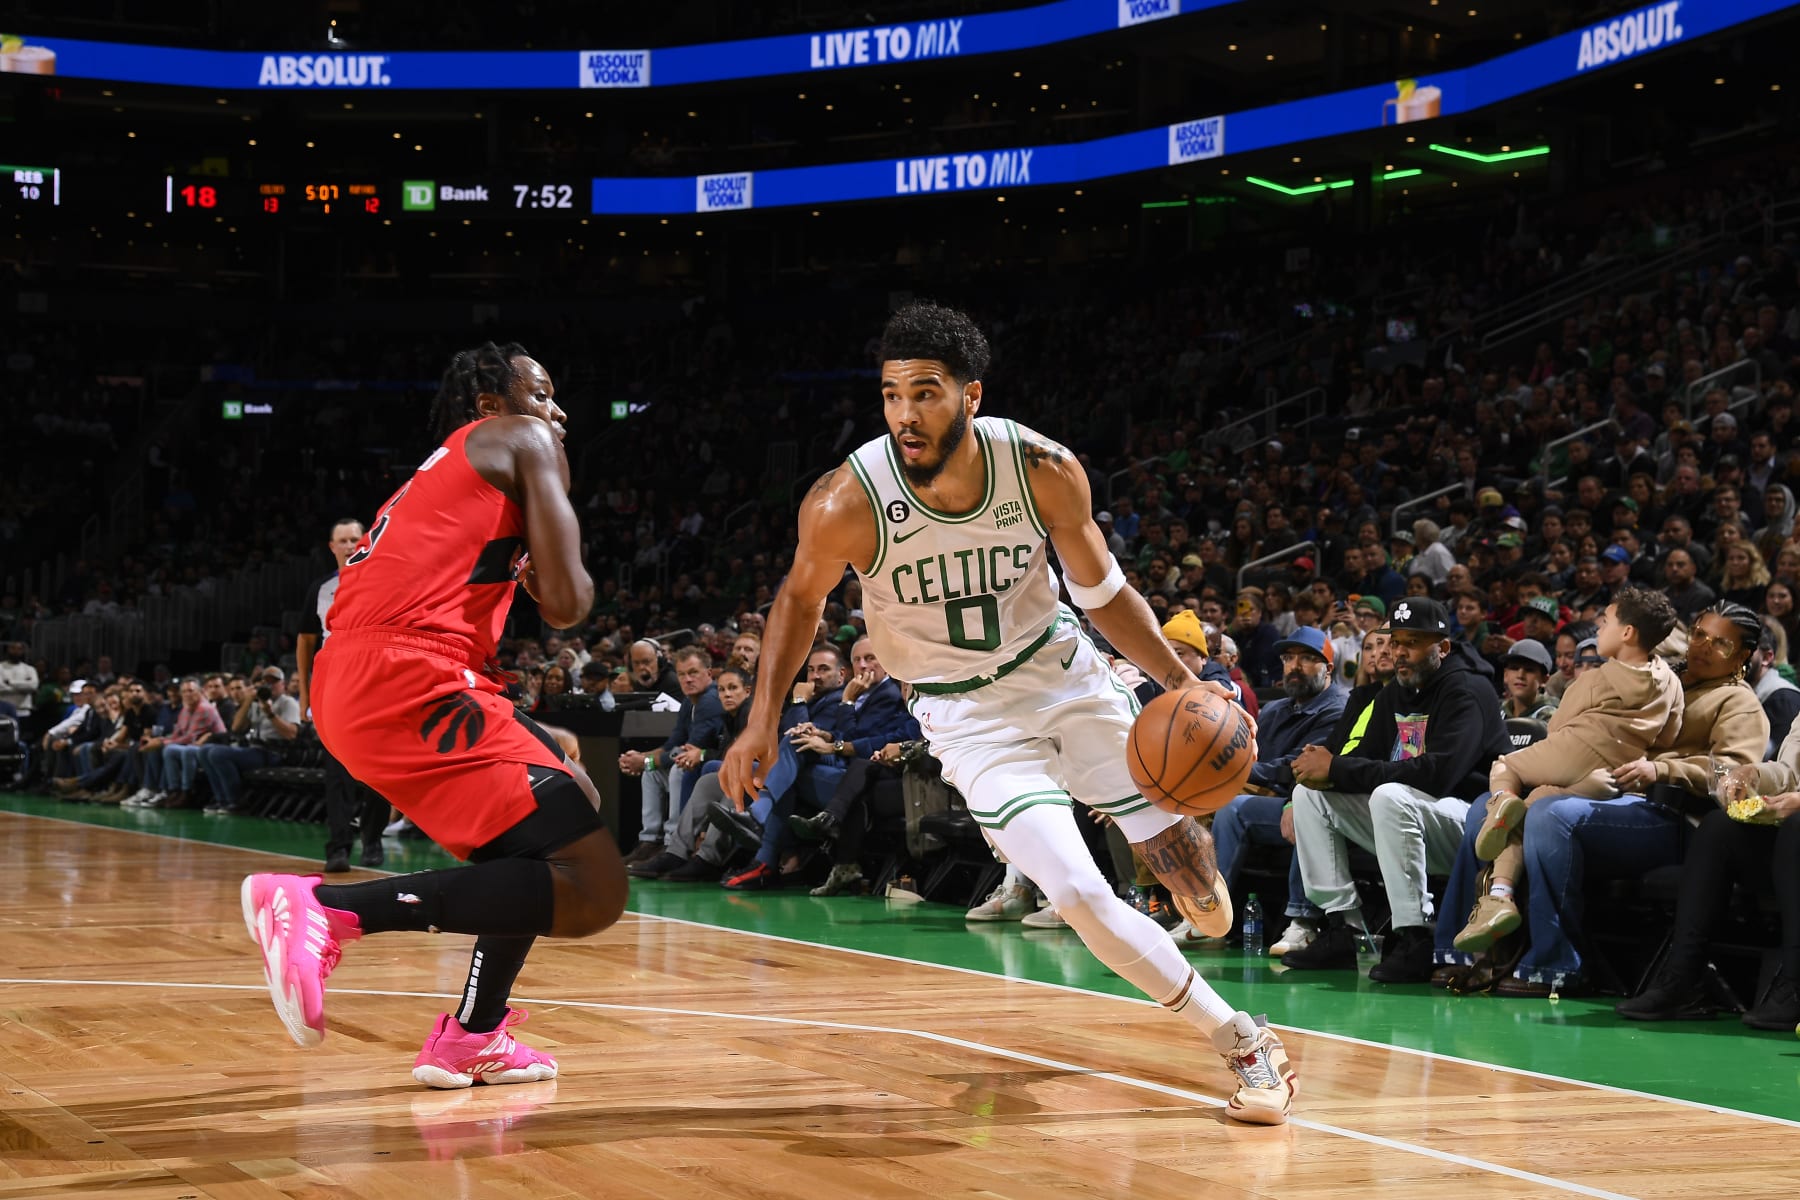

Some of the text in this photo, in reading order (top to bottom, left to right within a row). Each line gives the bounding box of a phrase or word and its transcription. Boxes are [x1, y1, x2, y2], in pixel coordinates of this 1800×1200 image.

[810, 19, 963, 68] LIVE TO MIX
[588, 54, 644, 69] ABSOLUT
[593, 69, 640, 83] VODKA
[1176, 119, 1218, 141] ABSOLUT
[1180, 136, 1215, 157] VODKA
[896, 149, 1033, 194] LIVE TO MIX
[20, 185, 40, 200] 10
[704, 176, 747, 193] ABSOLUT
[181, 185, 217, 208] 18
[406, 185, 489, 206] TD Bank
[513, 184, 573, 208] 7:52
[707, 191, 743, 207] VODKA
[891, 503, 905, 521] 6
[992, 500, 1022, 520] VISTA
[995, 513, 1024, 529] PRINT
[891, 544, 1032, 605] CELTICS
[945, 594, 1001, 651] 0
